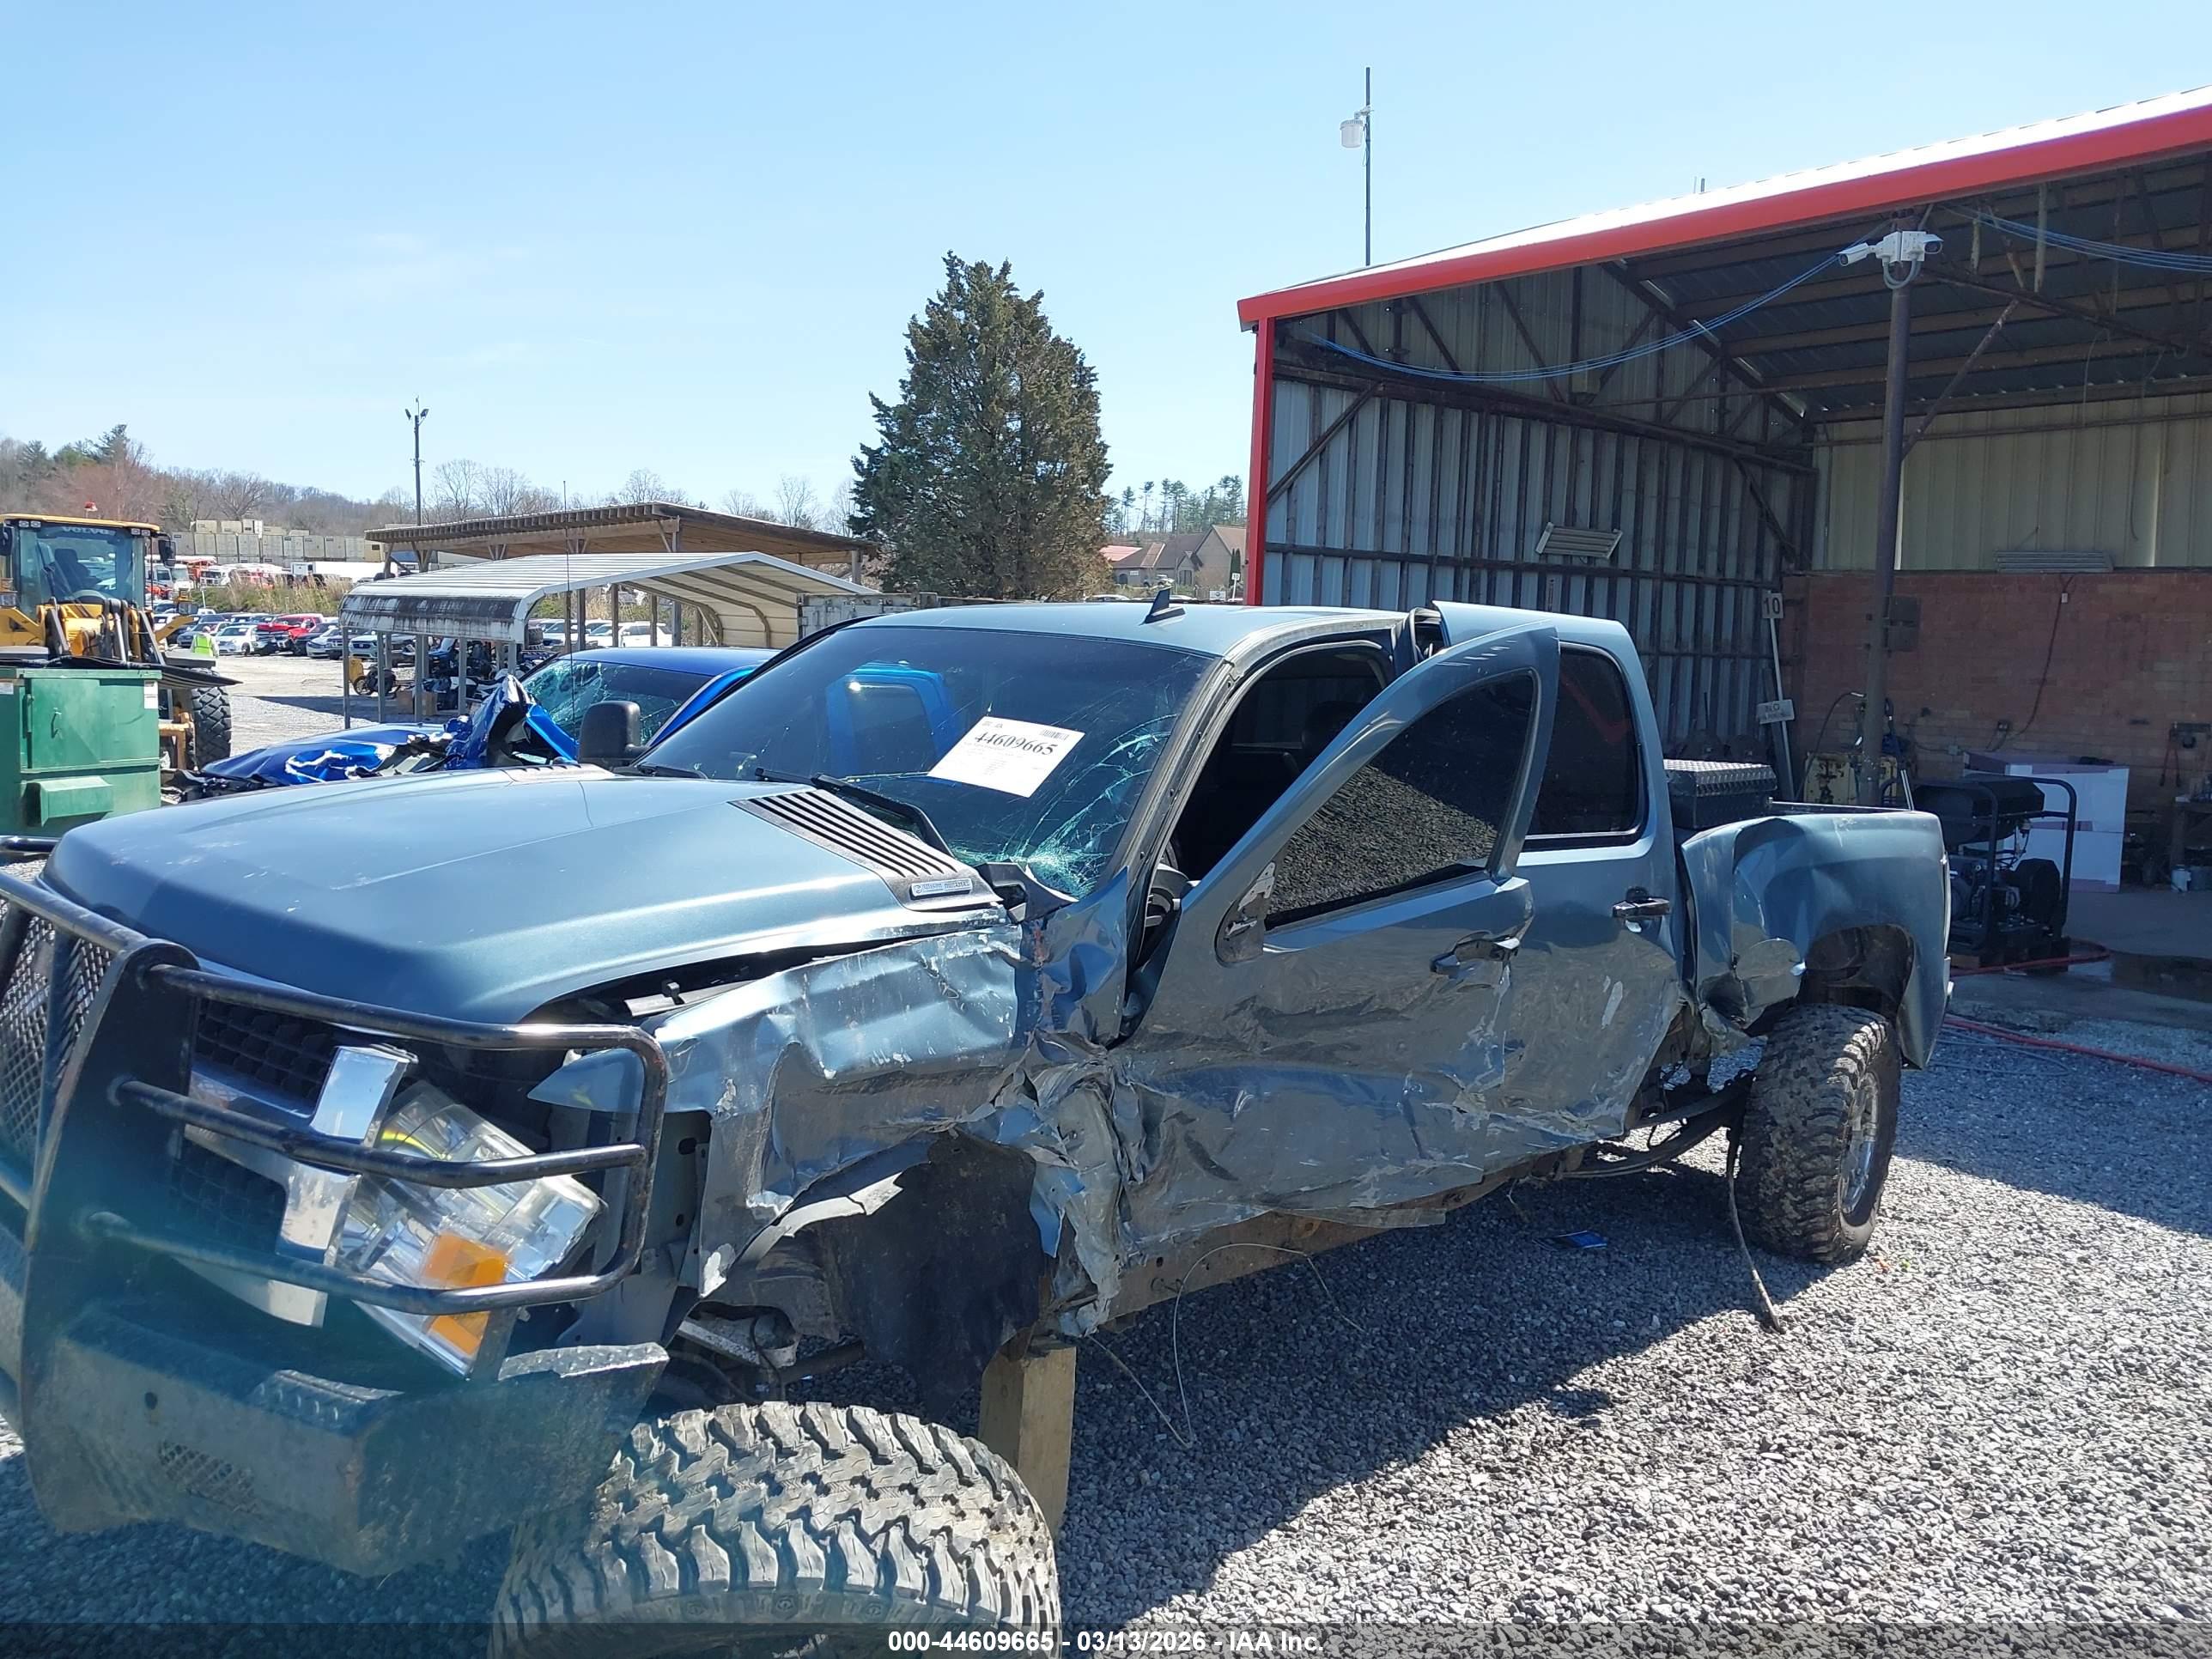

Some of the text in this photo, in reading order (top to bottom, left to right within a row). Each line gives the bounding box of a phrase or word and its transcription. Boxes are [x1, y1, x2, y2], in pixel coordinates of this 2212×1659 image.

[62, 526, 115, 536] VOLVO
[1764, 597, 1780, 615] 10
[975, 732, 1059, 756] 44609665
